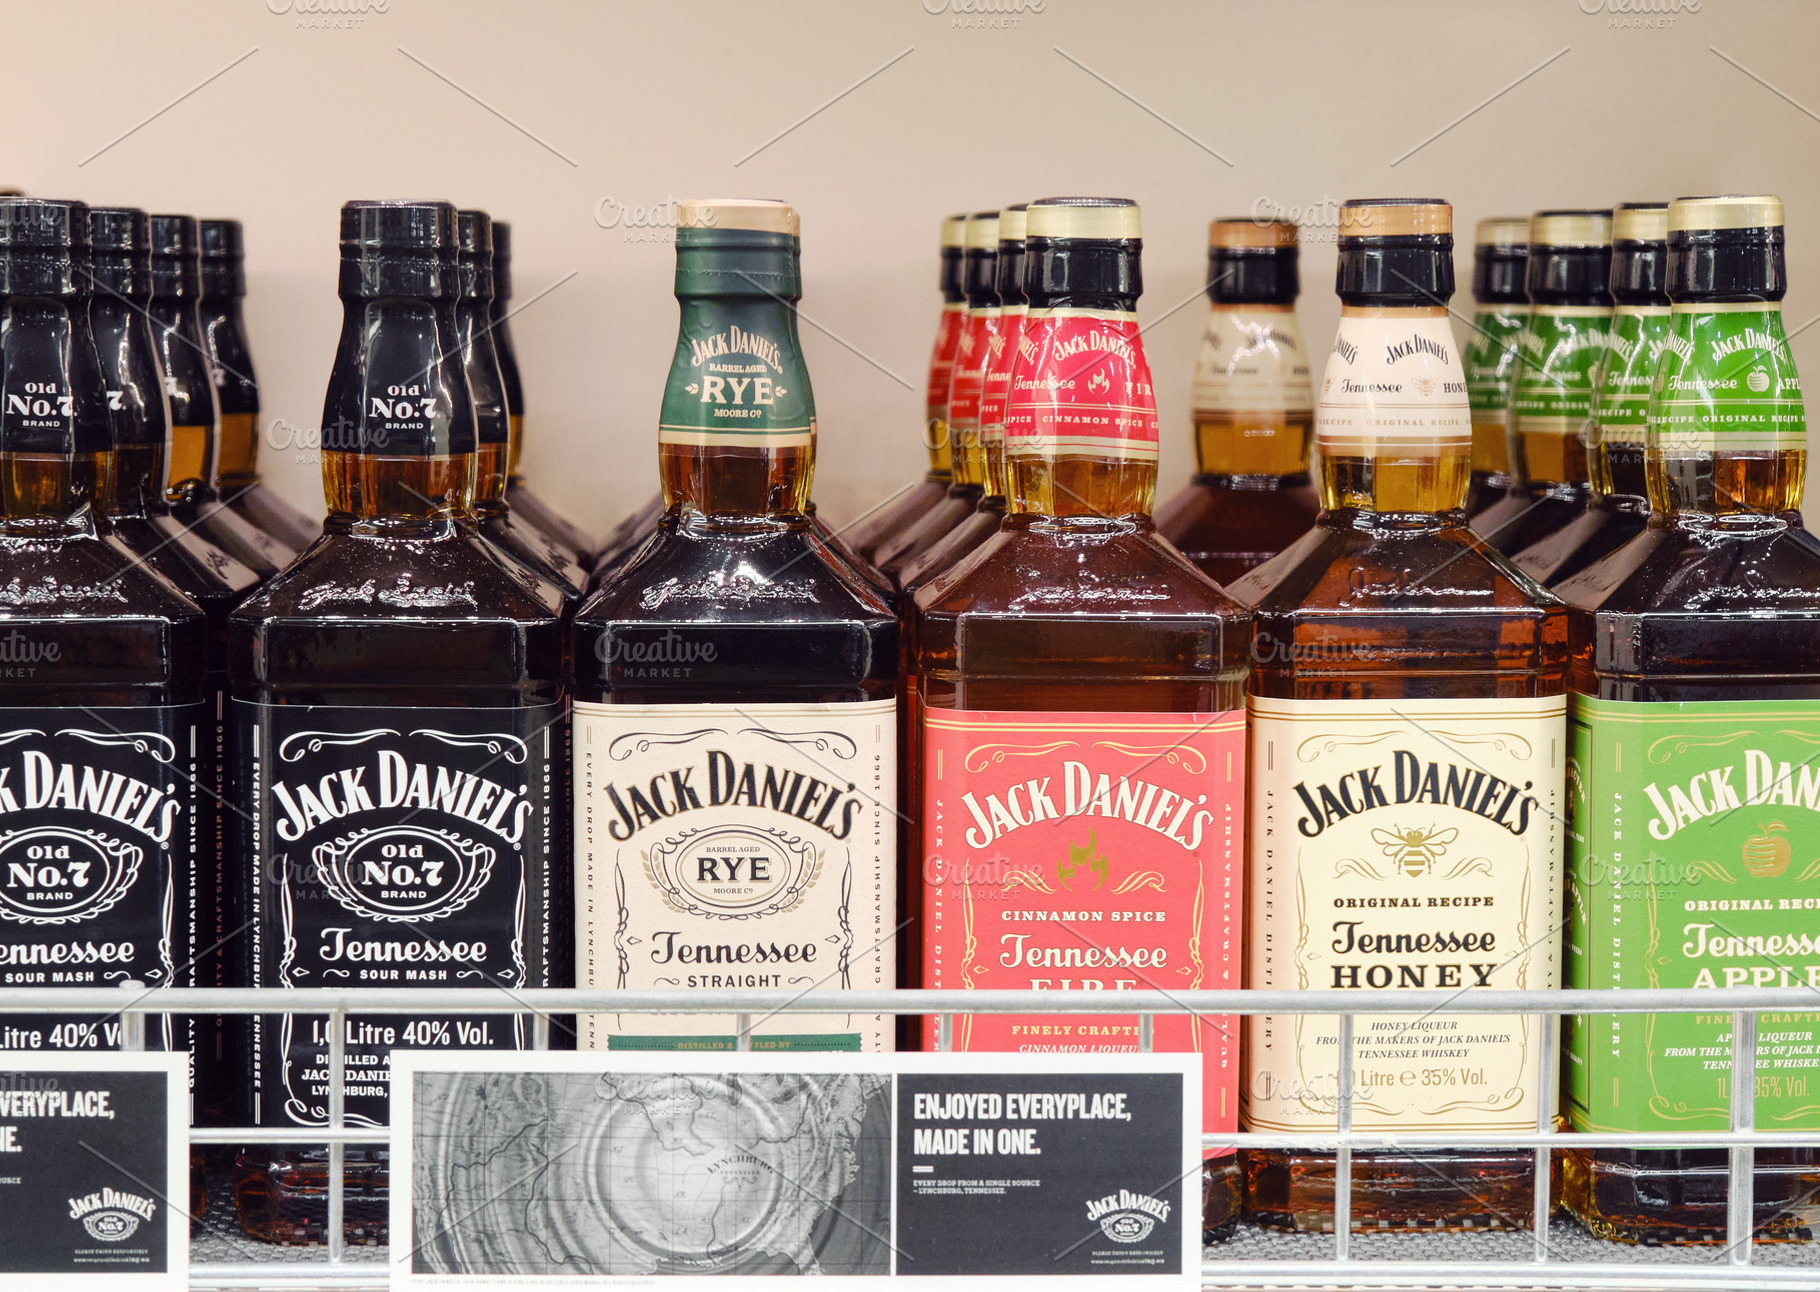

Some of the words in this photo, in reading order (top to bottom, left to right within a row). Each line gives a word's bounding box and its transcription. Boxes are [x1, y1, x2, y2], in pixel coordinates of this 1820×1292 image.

[691, 333, 729, 367] JACK
[730, 325, 781, 369] DANIEL'S
[1055, 335, 1087, 361] JACK
[1387, 339, 1414, 365] JACK
[1414, 333, 1449, 365] DANIEL'S
[1710, 334, 1746, 361] JACK
[709, 363, 743, 373] BARREL
[745, 364, 767, 373] AGED
[24, 382, 57, 394] Old
[387, 385, 420, 397] Old
[700, 375, 774, 405] RYE
[1341, 379, 1403, 394] Tennessee
[1669, 374, 1738, 391] Tennessee
[7, 394, 76, 417] No.7
[369, 397, 437, 419] No.7
[713, 409, 748, 418] MOORE
[22, 420, 60, 428] BRAND
[385, 422, 424, 430] BRAND
[1043, 416, 1110, 425] CINNAMON
[1115, 419, 1143, 428] SPICE
[1366, 419, 1425, 427] ORIGINAL
[1702, 415, 1766, 423] ORIGINAL
[22, 750, 182, 843] DANIEL'S
[253, 763, 261, 809] EVERY
[271, 765, 376, 841] JACK
[378, 750, 534, 844] DANIEL'S
[603, 765, 705, 841] JACK
[706, 749, 863, 842] DANIEL'S
[1293, 765, 1391, 838] JACK
[1392, 749, 1540, 837] DANIEL'S
[960, 776, 1061, 850] JACK
[1062, 761, 1215, 852] DANIEL'S
[1266, 791, 1274, 838] JACK
[1643, 765, 1742, 841] JACK
[935, 799, 944, 848] JACK
[1613, 793, 1622, 841] JACK
[253, 812, 261, 850] DROP
[27, 845, 70, 860] Old
[381, 844, 424, 859] Old
[7, 861, 92, 888] No.7
[253, 855, 261, 895] MADE
[361, 860, 444, 887] No.7
[697, 857, 773, 883] RYE
[381, 890, 427, 899] BRAND
[1222, 803, 1231, 962] CRAFTSMANSHIP
[1265, 849, 1273, 922] DANIEL
[1612, 852, 1621, 926] DANIEL
[27, 892, 74, 900] BRAND
[253, 898, 261, 914] IN
[588, 899, 593, 914] IN
[935, 859, 943, 933] DANIEL
[1333, 898, 1421, 908] ORIGINAL
[1428, 896, 1494, 907] RECIPE
[1684, 899, 1773, 912] ORIGINAL
[1001, 910, 1103, 922] CINNAMON
[1110, 910, 1166, 922] SPICE
[320, 927, 487, 962] Tennessee
[651, 931, 817, 964] Tennessee
[1331, 920, 1496, 954] Tennessee
[1000, 934, 1167, 968] Tennessee
[5, 972, 46, 983] SOUR
[52, 971, 95, 983] MASH
[359, 969, 399, 980] SOUR
[406, 969, 448, 980] MASH
[687, 975, 781, 988] STRAIGHT
[1330, 962, 1497, 989] HONEY
[49, 1022, 98, 1048] 40%
[346, 1020, 396, 1045] Litre
[402, 1020, 450, 1045] 40%
[456, 1020, 494, 1045] Vol.
[1011, 1025, 1072, 1035] FINELY
[1370, 1021, 1409, 1031] HONEY
[1411, 1021, 1458, 1031] LIQUEUR
[1758, 1031, 1813, 1044] LIQUEUR
[779, 1041, 791, 1049] BY
[1018, 1044, 1088, 1053] CINNAMON
[1375, 1035, 1419, 1045] MAKERS
[1422, 1035, 1437, 1044] OF
[1437, 1035, 1464, 1046] JACK
[1466, 1034, 1511, 1044] DANIEL'S
[1664, 1047, 1697, 1057] FROM
[1698, 1047, 1722, 1056] THE
[1772, 1045, 1787, 1055] OF
[1787, 1045, 1814, 1057] JACK
[1358, 1049, 1419, 1059] TENNESSEE
[1421, 1049, 1470, 1059] WHISKEY
[1361, 1069, 1395, 1087] Litre
[1421, 1068, 1456, 1087] 35%
[1460, 1067, 1488, 1086] Vol.
[1786, 1075, 1810, 1097] Vol.
[914, 1093, 1002, 1119] ENJOYED
[1005, 1093, 1132, 1121] EVERYPLACE,
[914, 1129, 969, 1155] MADE
[973, 1129, 994, 1154] IN
[997, 1129, 1041, 1155] ONE.
[68, 1193, 103, 1219] JACK
[102, 1187, 157, 1221] DANIEL'S
[1085, 1194, 1120, 1221] JACK
[1119, 1188, 1171, 1223] DANIEL'S
